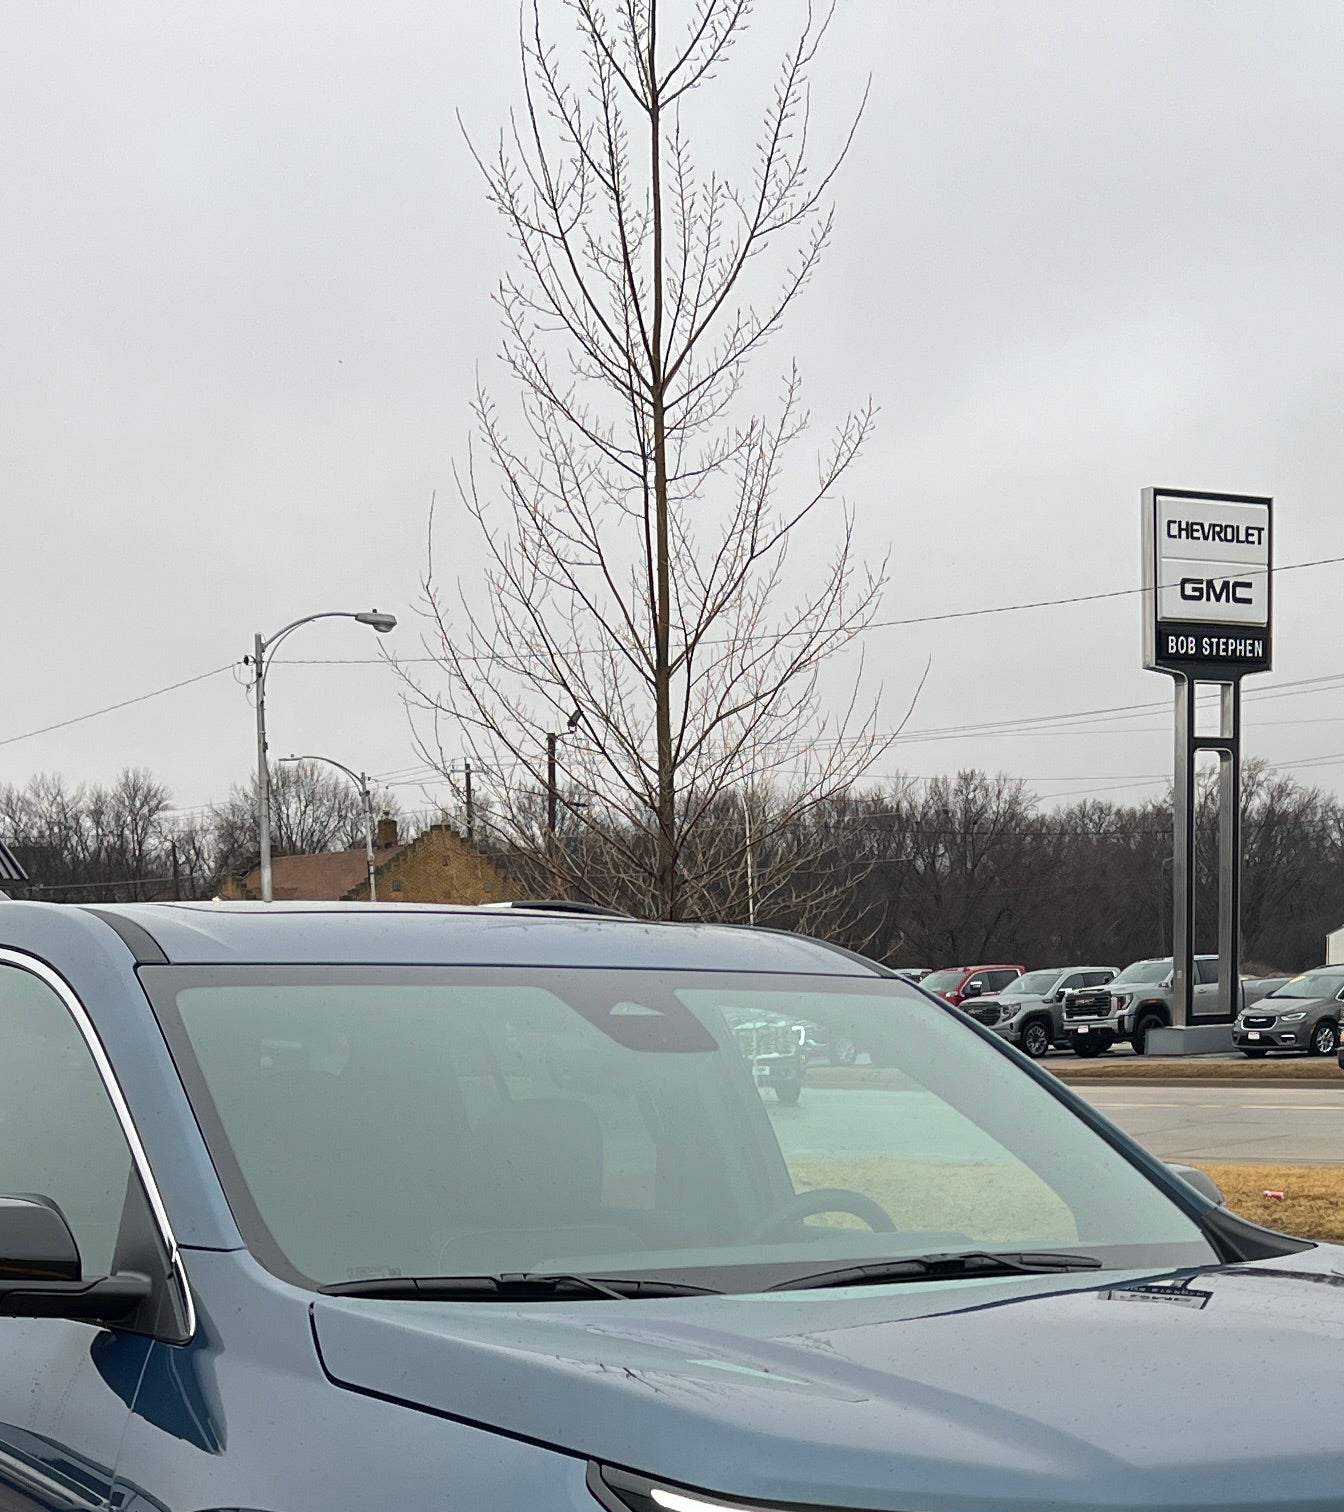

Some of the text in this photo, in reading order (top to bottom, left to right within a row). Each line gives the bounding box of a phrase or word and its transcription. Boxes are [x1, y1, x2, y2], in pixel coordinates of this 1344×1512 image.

[1166, 519, 1265, 546] CHEVROLET
[1180, 577, 1253, 605] GMC
[1167, 635, 1263, 657] BOB STEPHEN
